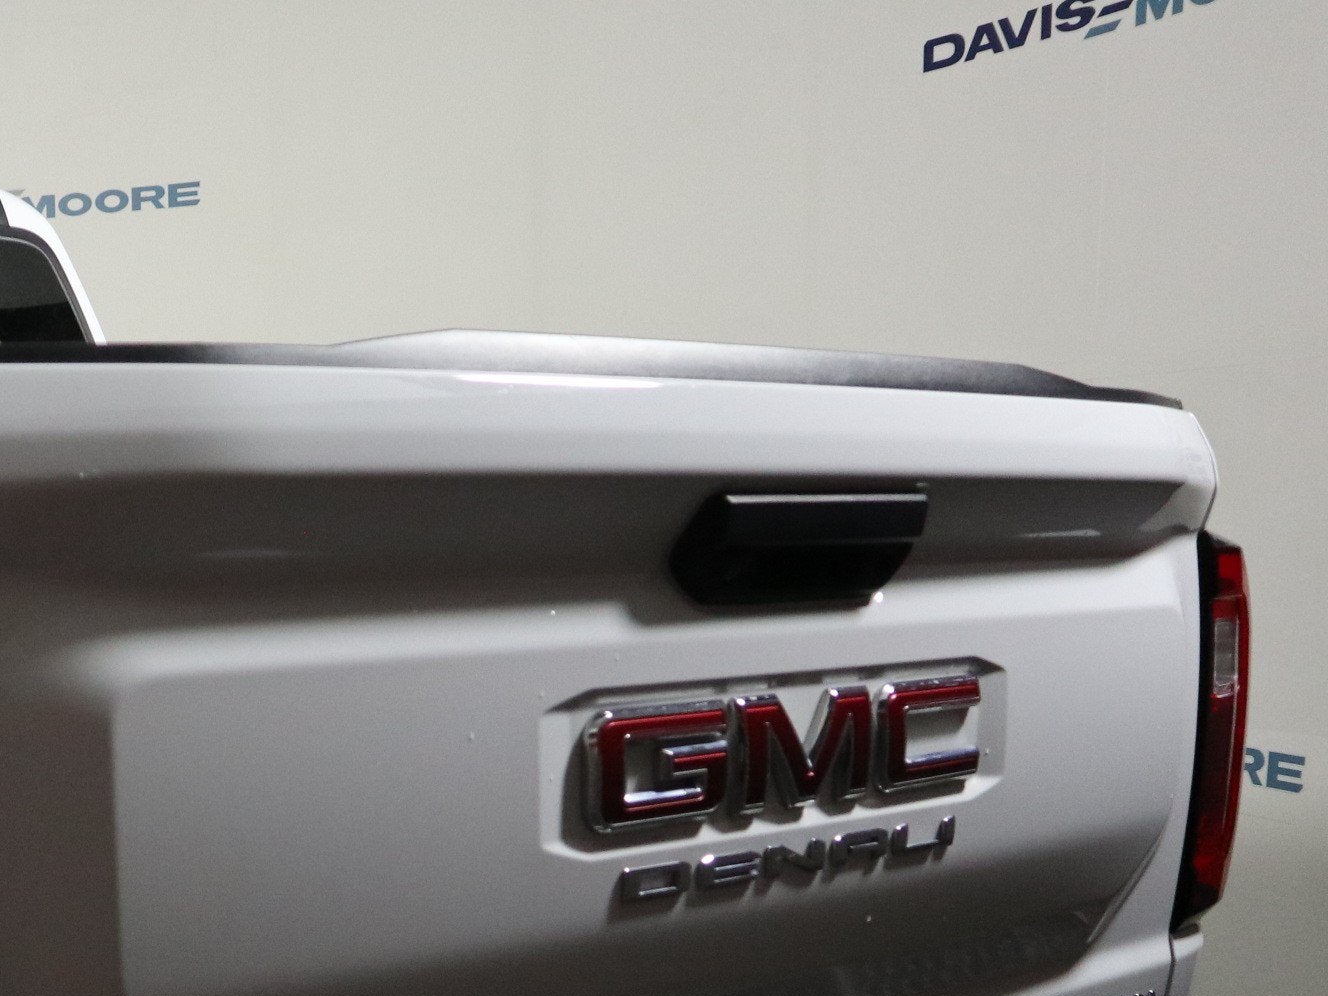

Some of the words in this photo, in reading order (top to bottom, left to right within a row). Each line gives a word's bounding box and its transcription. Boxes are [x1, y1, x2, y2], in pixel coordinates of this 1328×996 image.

[922, 0, 1097, 73] DAVIS
[22, 181, 201, 219] MOORE
[583, 676, 981, 833] GMC
[619, 815, 956, 899] DENALI
